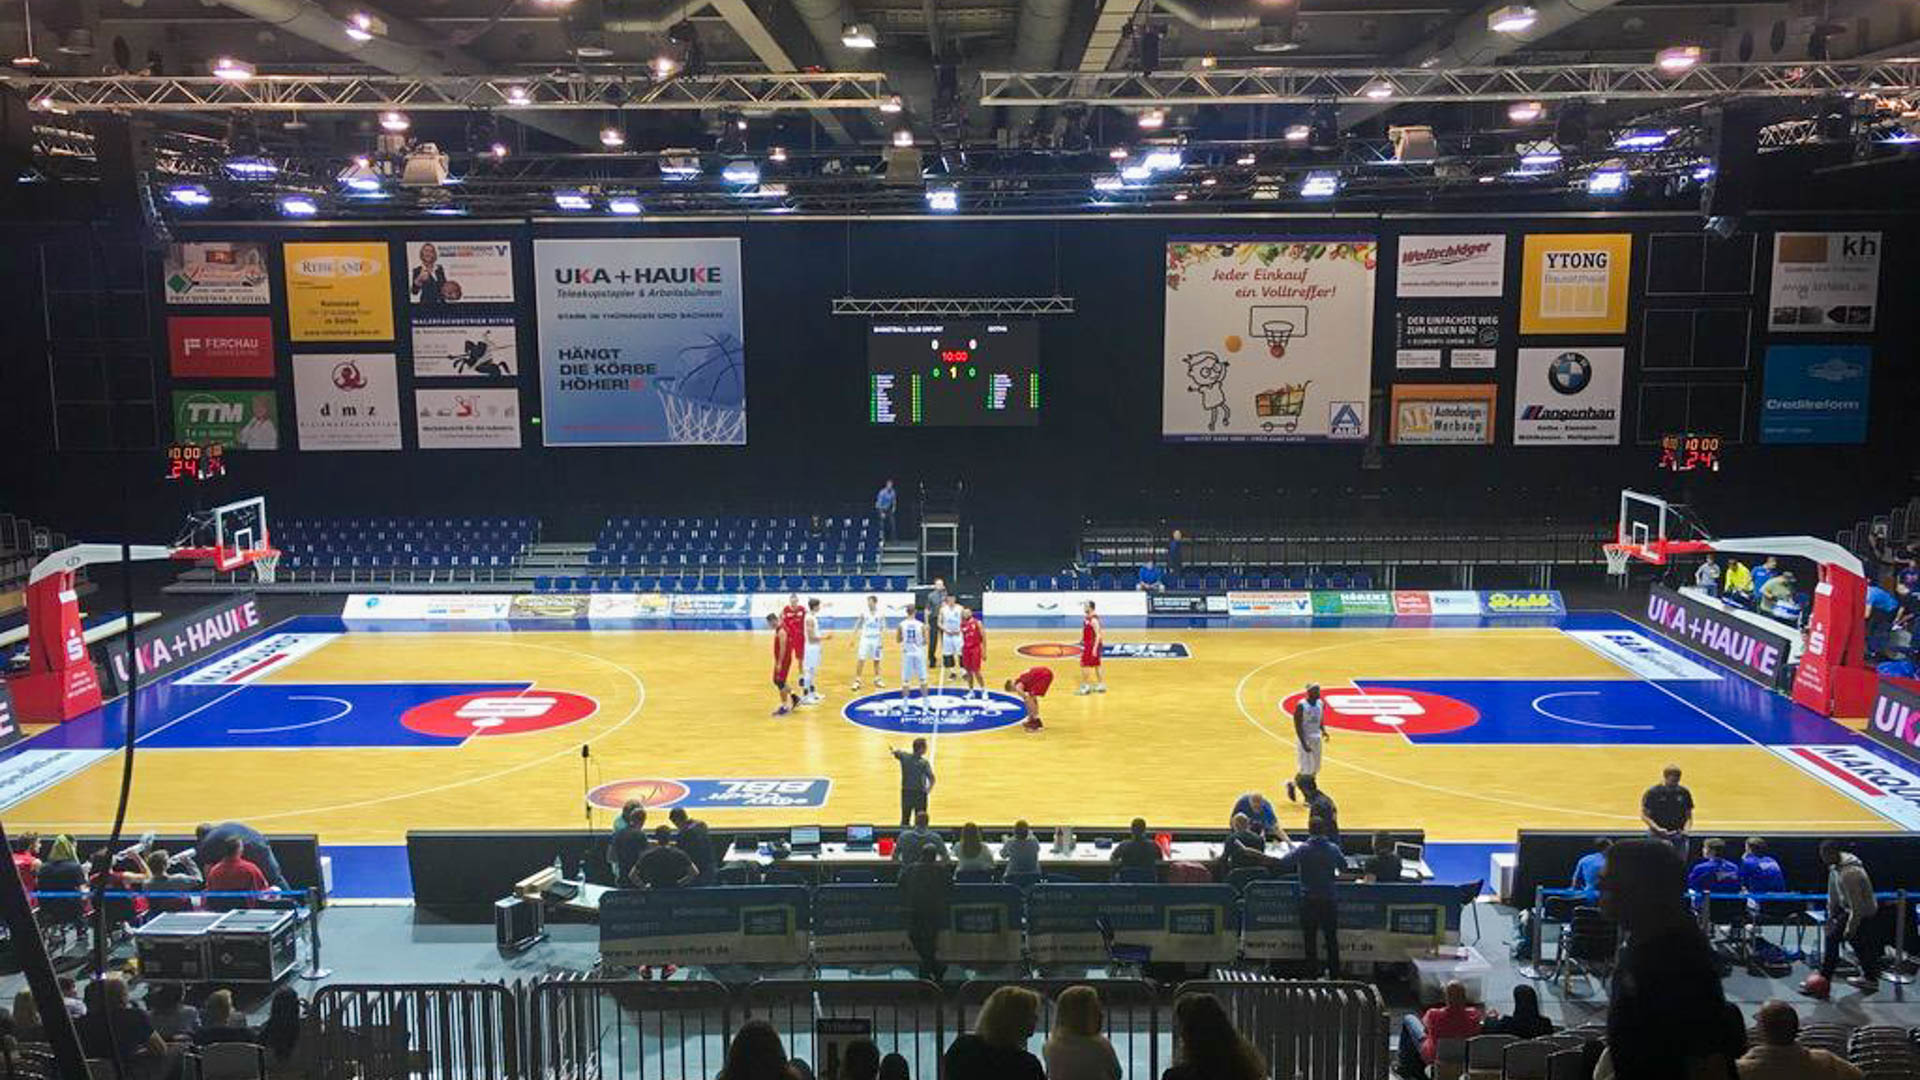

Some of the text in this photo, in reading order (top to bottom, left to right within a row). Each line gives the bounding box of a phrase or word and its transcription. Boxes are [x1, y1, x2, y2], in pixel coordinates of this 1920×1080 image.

[1843, 235, 1876, 256] kh
[1546, 252, 1608, 268] YTONG
[555, 267, 611, 284] UKA
[635, 267, 721, 284] HAUKE
[1212, 267, 1310, 283] Jeder Einkauf
[1235, 286, 1336, 301] ein Volltreffer!
[1407, 316, 1499, 325] DER EINFACHSTE WEG
[1407, 326, 1426, 335] ZUM
[205, 338, 259, 349] FERCHAU
[558, 346, 623, 361] HÄNGT
[560, 361, 657, 376] DIE KÖRBE
[950, 366, 957, 379] 1
[560, 377, 629, 391] HÖHER!
[187, 402, 243, 423] TTM
[1687, 451, 1712, 468] 24
[172, 461, 196, 477] 24
[186, 601, 260, 651] HAUKE
[1647, 594, 1686, 634] UKA
[1701, 617, 1779, 677] HAUKE
[718, 781, 814, 793] BBL
